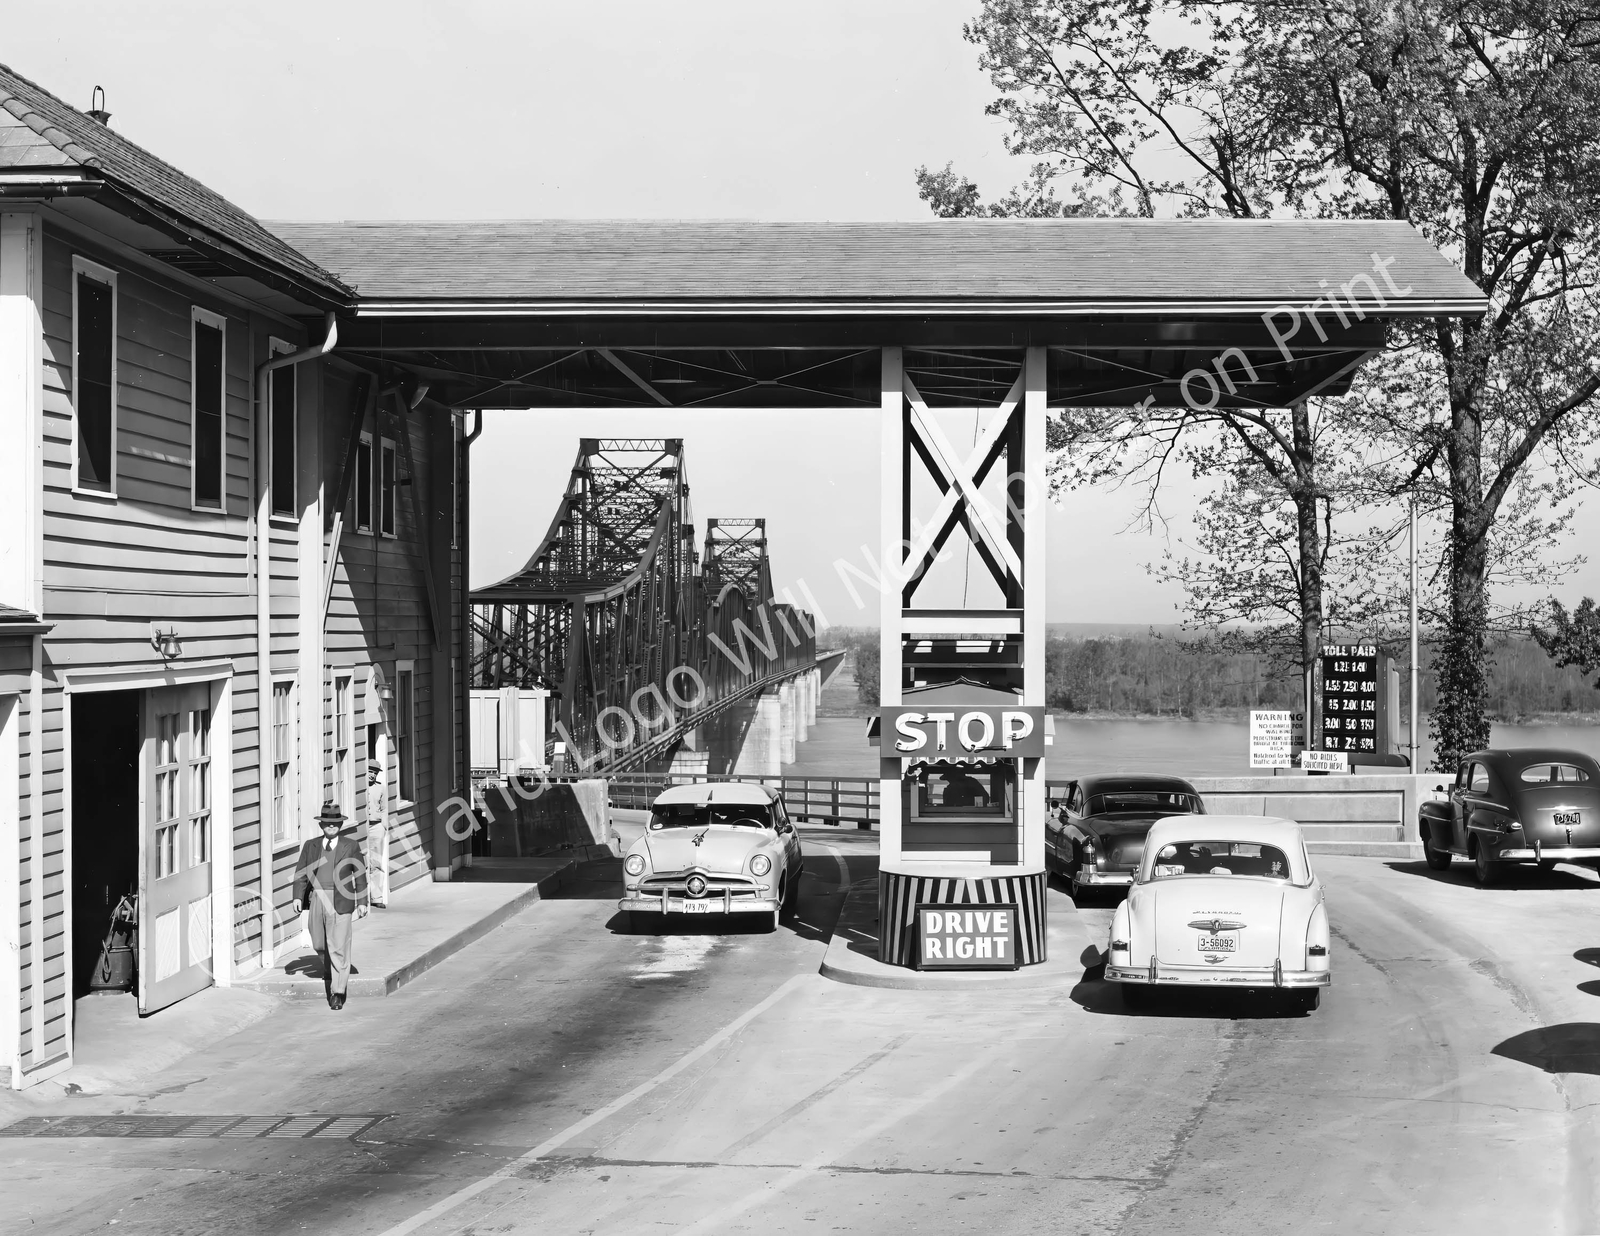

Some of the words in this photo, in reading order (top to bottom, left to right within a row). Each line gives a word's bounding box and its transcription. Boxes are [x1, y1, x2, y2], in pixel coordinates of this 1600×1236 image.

[1323, 645, 1348, 656] TOLL
[1351, 645, 1376, 657] PAID
[1255, 713, 1304, 721] WARNING
[1345, 718, 1357, 730] 50
[895, 711, 1034, 752] STOP
[1320, 753, 1338, 761] RIDES
[1329, 762, 1343, 770] HERE
[925, 912, 1009, 934] DRIVE
[925, 937, 1009, 959] RIGHT
[1200, 938, 1234, 948] 3-56092
